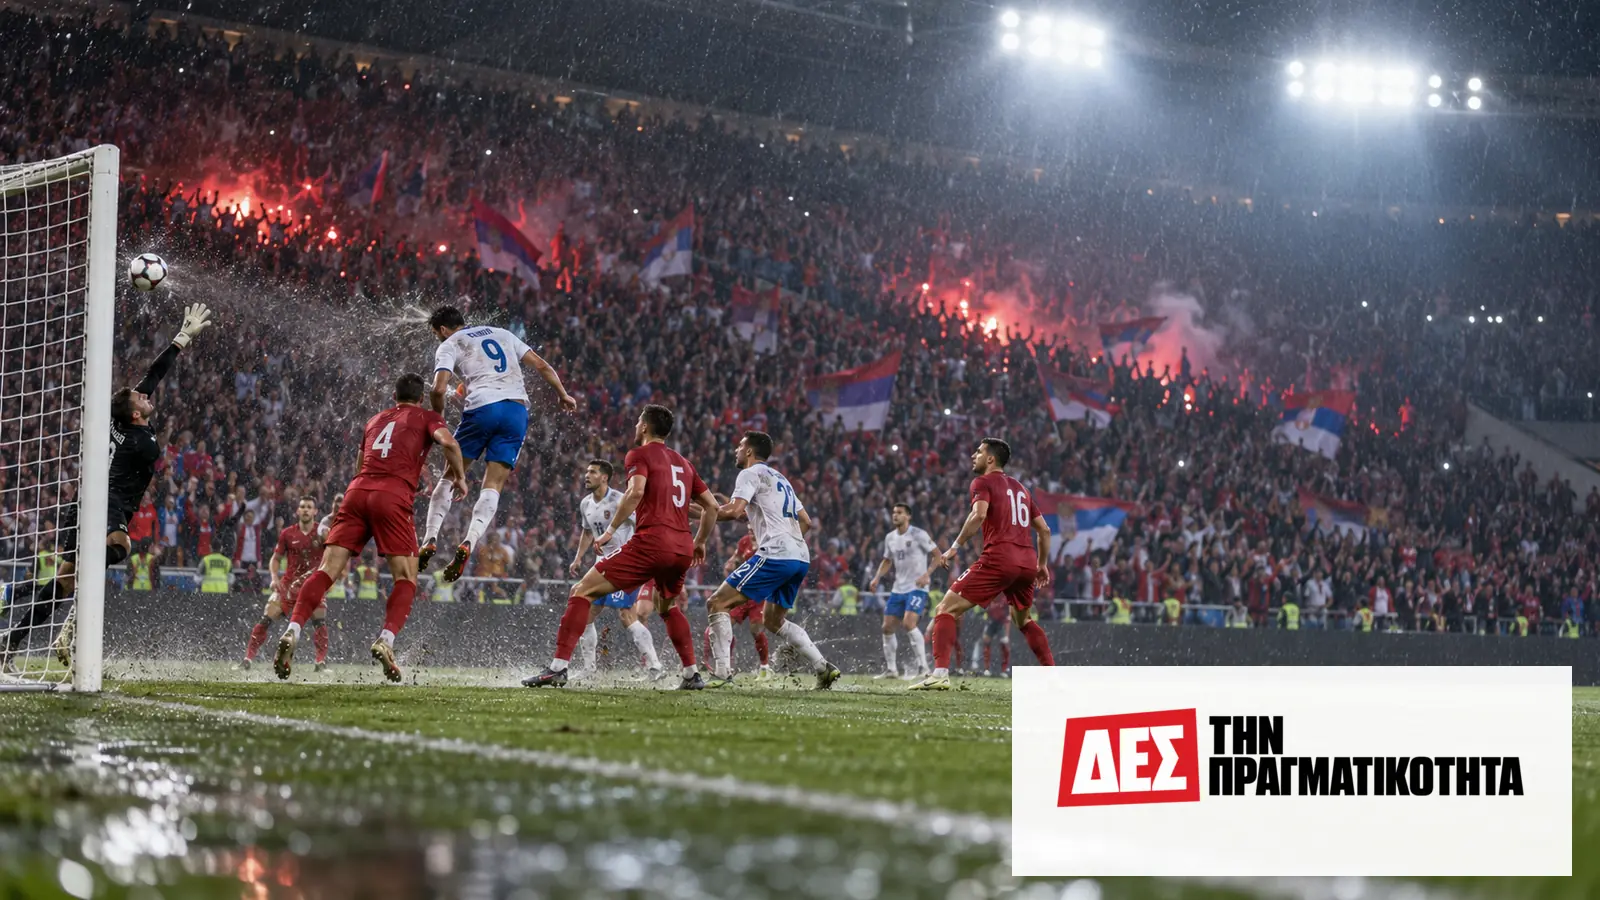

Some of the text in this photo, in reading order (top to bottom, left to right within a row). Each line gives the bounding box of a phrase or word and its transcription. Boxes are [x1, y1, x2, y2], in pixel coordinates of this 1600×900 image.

[481, 338, 507, 373] 9
[371, 421, 396, 458] 4
[670, 465, 686, 508] 5
[1006, 488, 1030, 528] 16
